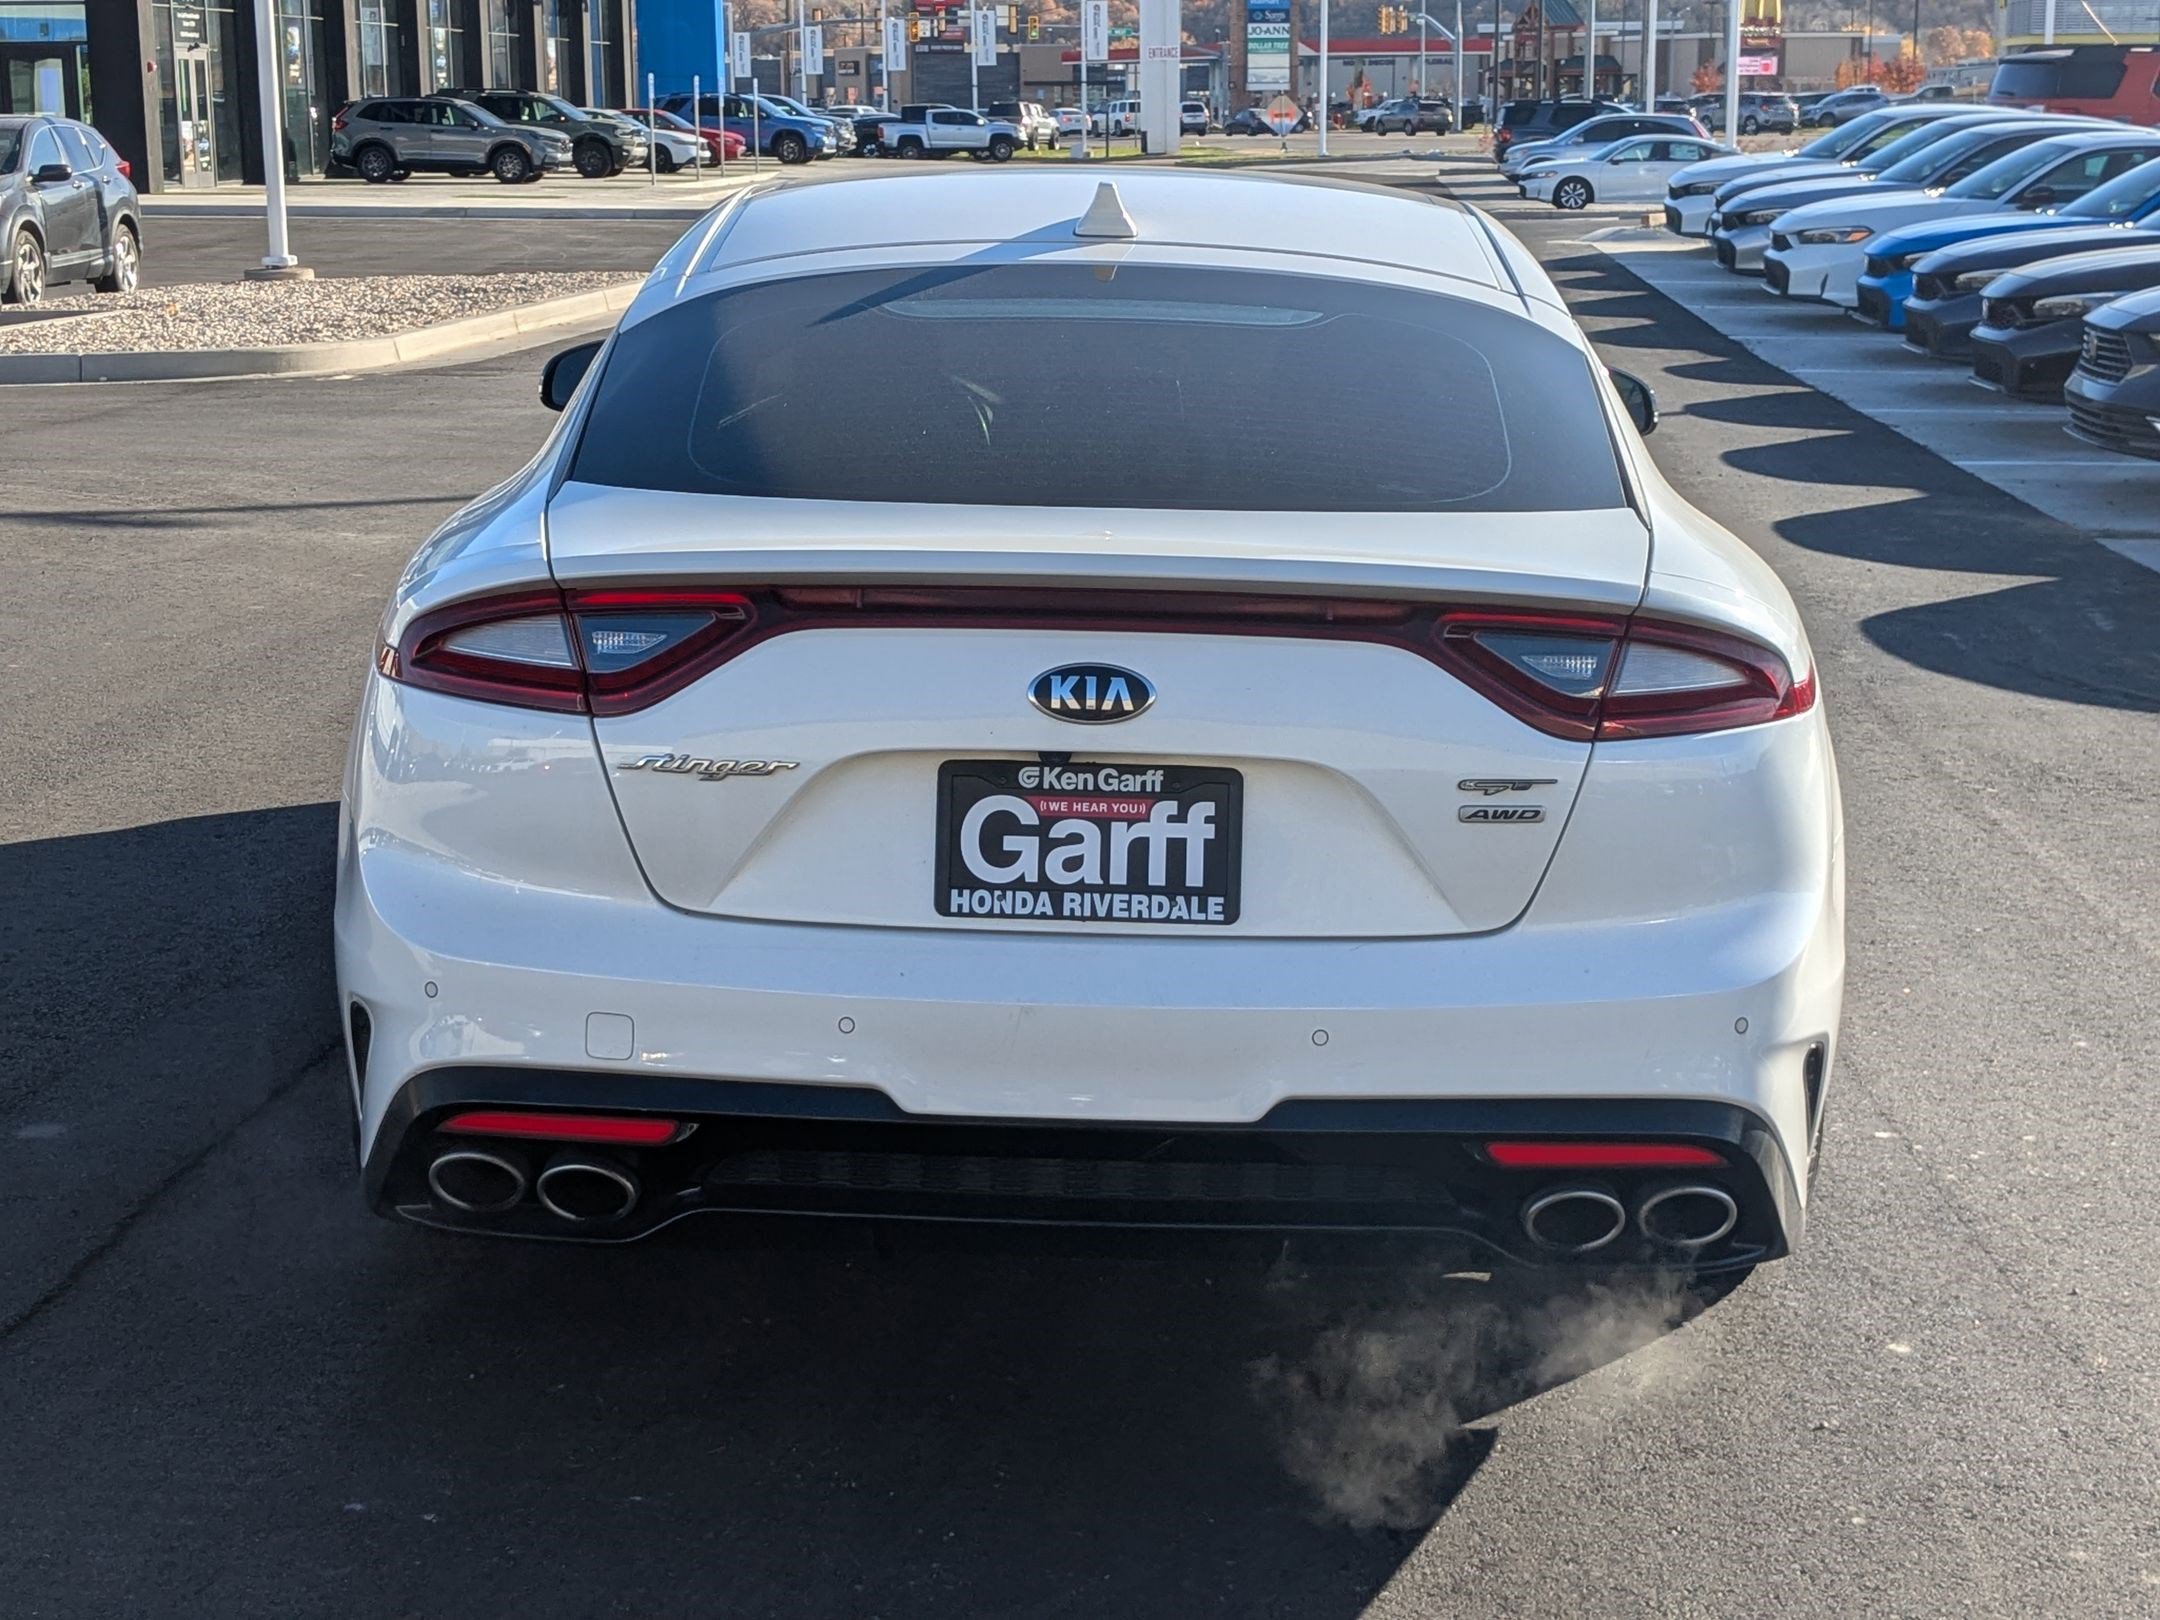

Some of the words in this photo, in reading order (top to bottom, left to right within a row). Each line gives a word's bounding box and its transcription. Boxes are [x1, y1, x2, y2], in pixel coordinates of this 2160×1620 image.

[1148, 47, 1179, 59] ENTRANCE
[1049, 674, 1135, 712] KIA
[617, 753, 801, 781] Stinger
[1043, 767, 1094, 791] Ken
[1097, 768, 1164, 793] Garff
[1072, 802, 1108, 813] HEAR
[1464, 809, 1541, 820] AWD
[959, 794, 1216, 888] Garff
[950, 889, 1054, 916] HONDA
[1062, 891, 1225, 921] RIVERDALE
